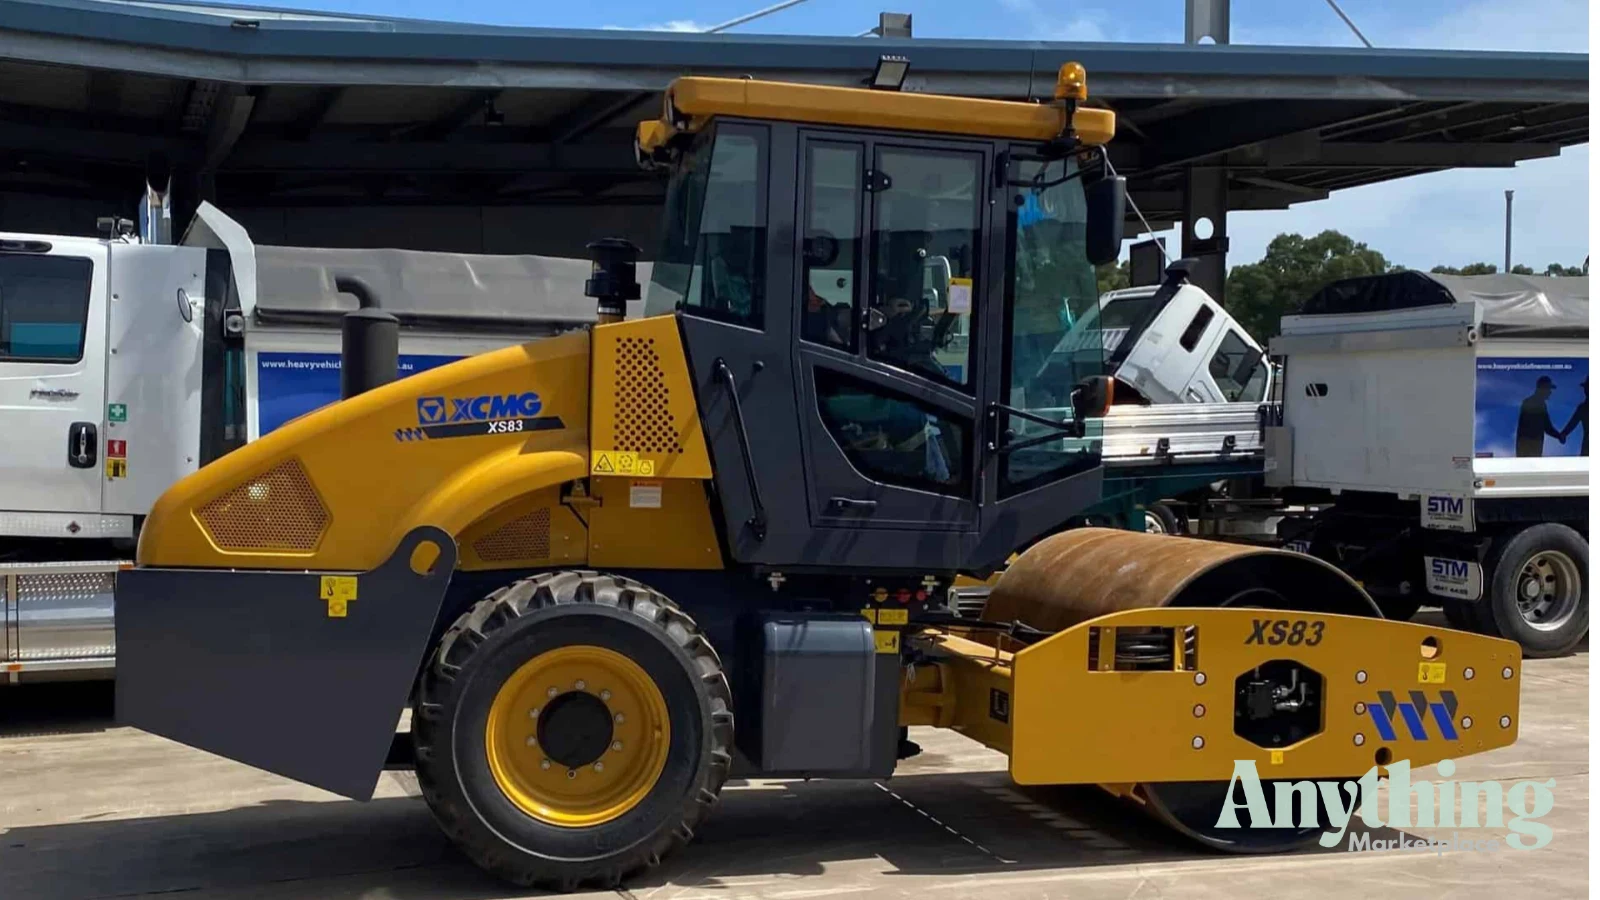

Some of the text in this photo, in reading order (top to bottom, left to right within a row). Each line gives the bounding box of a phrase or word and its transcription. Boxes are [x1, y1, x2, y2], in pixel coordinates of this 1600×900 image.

[449, 392, 542, 421] XCMG
[488, 420, 523, 434] XS83
[1428, 496, 1463, 514] STM
[1432, 558, 1468, 577] STM
[1244, 619, 1325, 646] XS83
